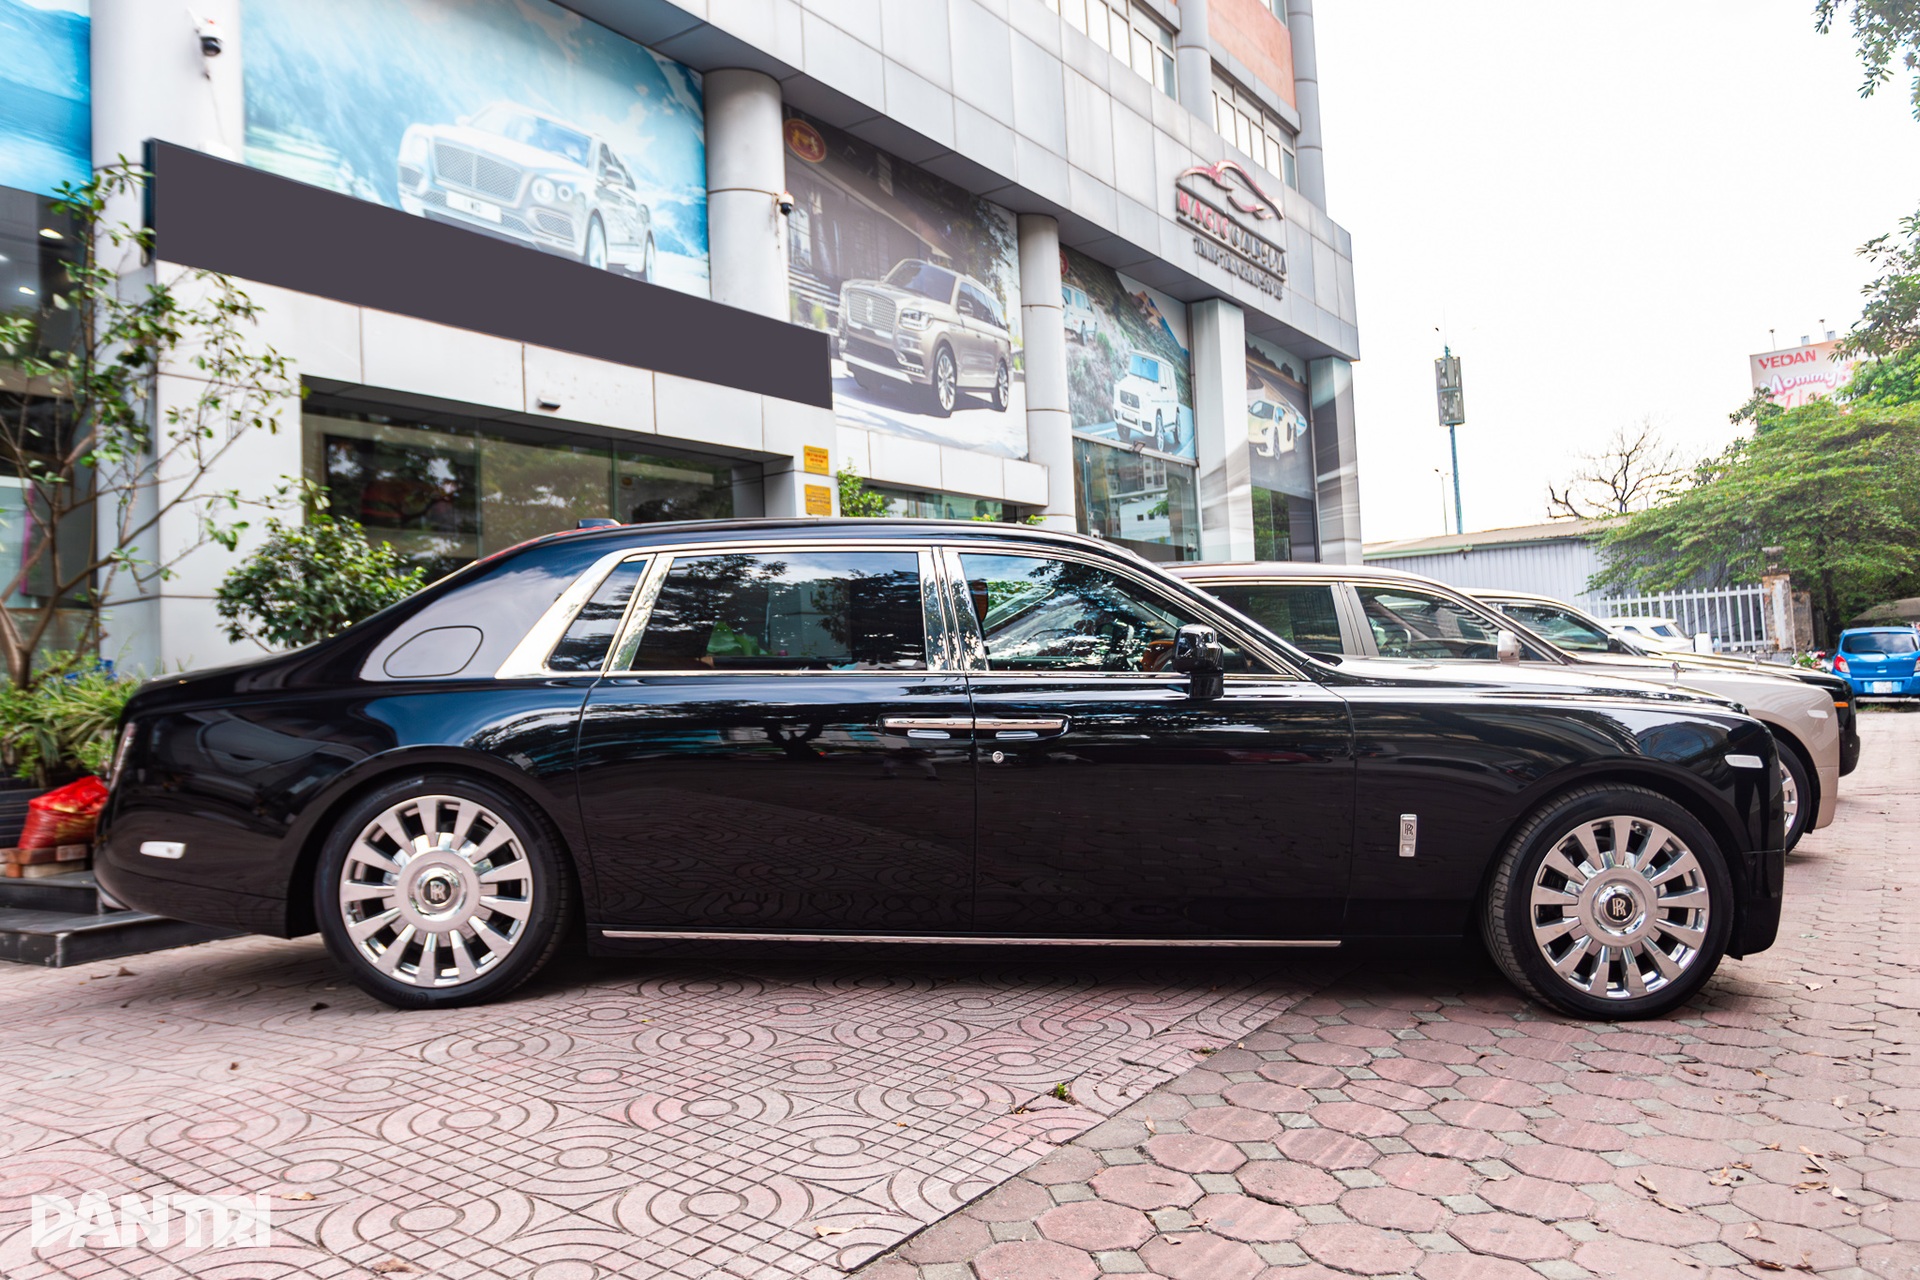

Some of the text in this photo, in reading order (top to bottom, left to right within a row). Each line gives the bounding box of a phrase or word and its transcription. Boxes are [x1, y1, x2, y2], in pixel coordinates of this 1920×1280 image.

[1177, 188, 1229, 239] MAGIC
[1758, 349, 1817, 370] VEDAN
[1760, 371, 1838, 396] Mommy
